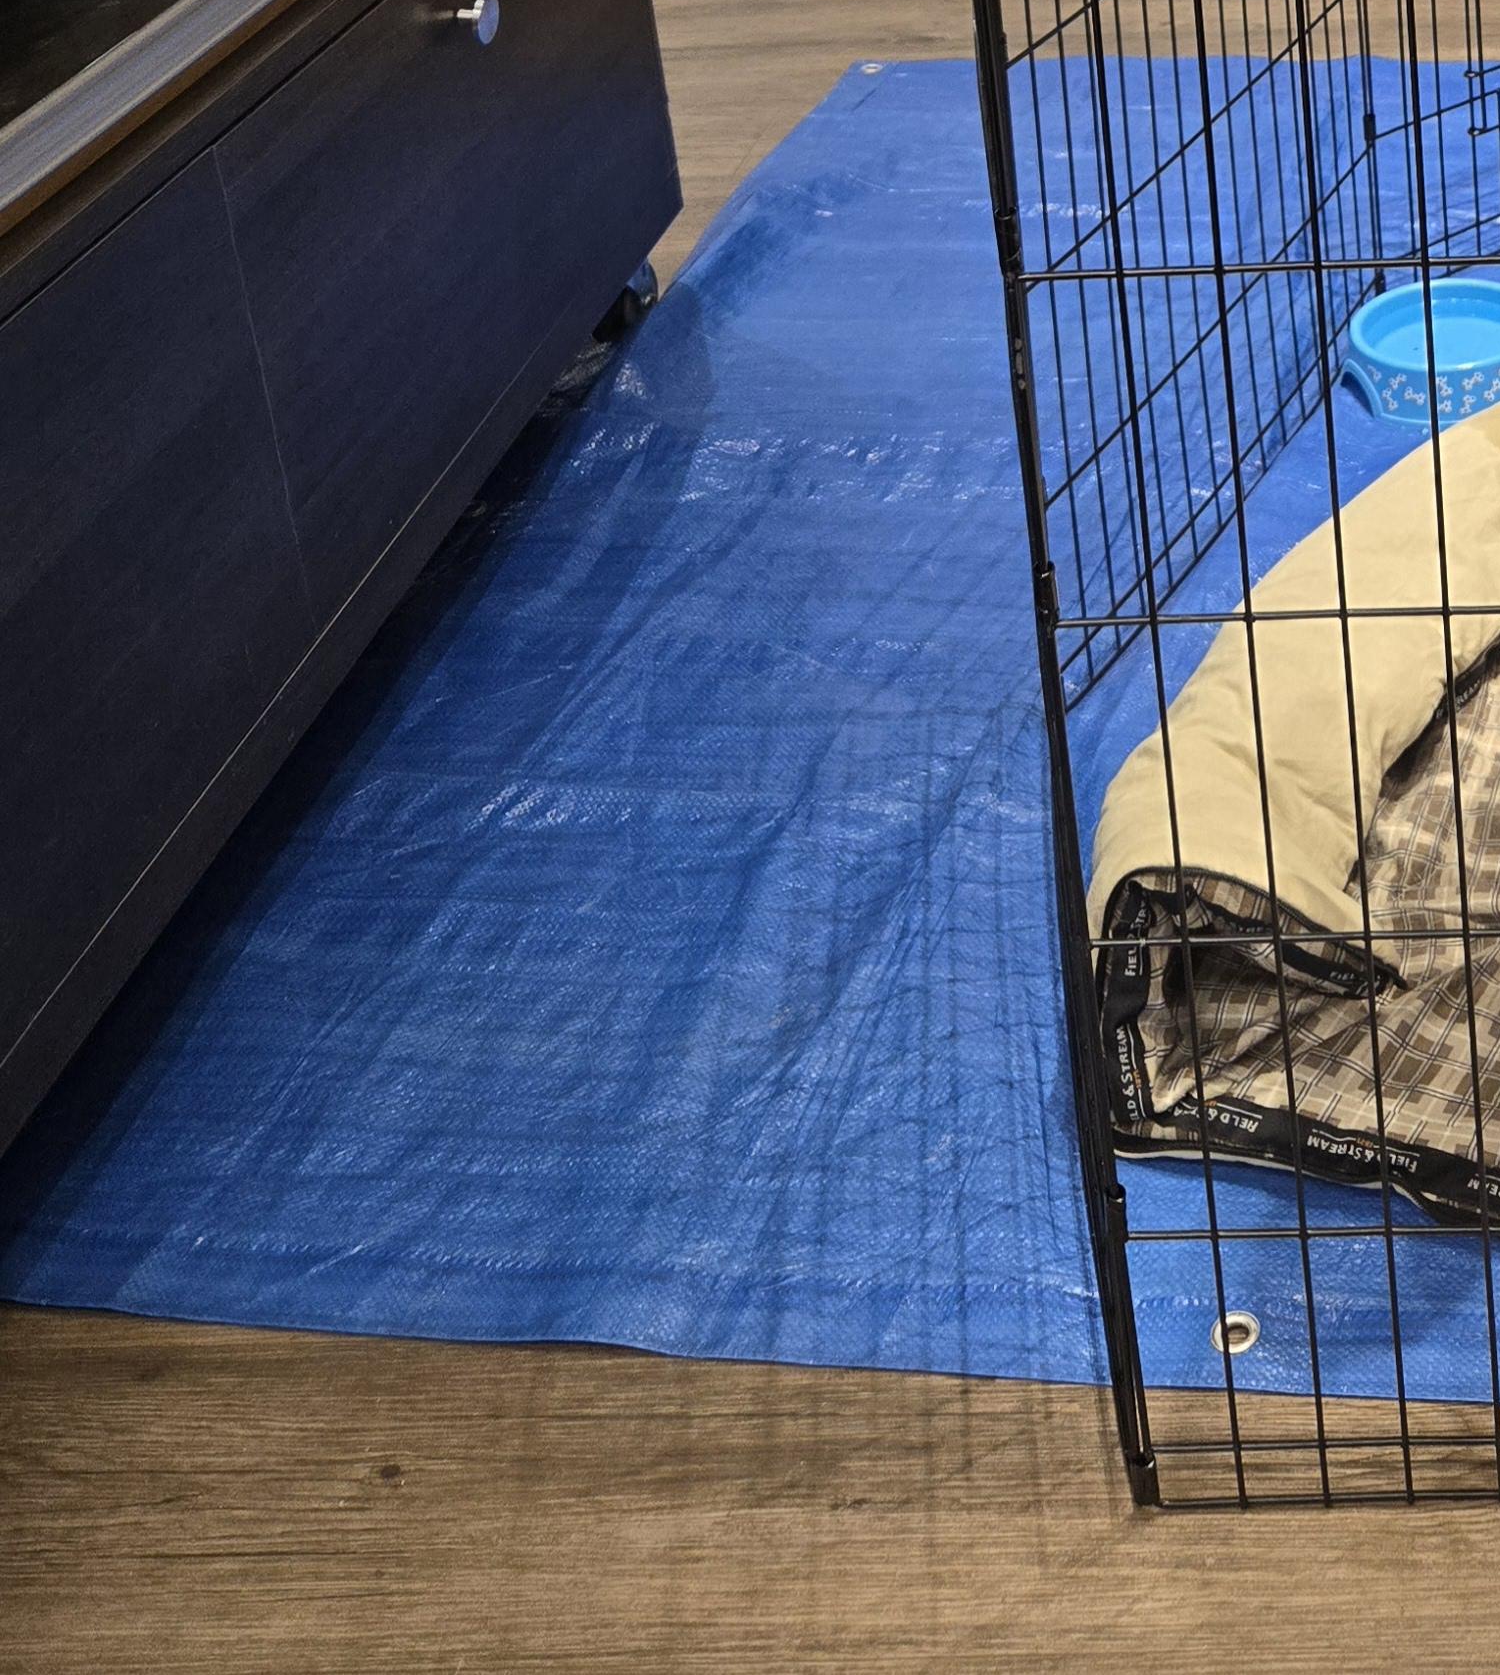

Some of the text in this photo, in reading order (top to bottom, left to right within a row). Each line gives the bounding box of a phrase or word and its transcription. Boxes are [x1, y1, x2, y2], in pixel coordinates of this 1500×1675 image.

[1116, 1025, 1133, 1085] STREAM
[1123, 1084, 1135, 1097] &
[1307, 1134, 1364, 1161] STREAM
